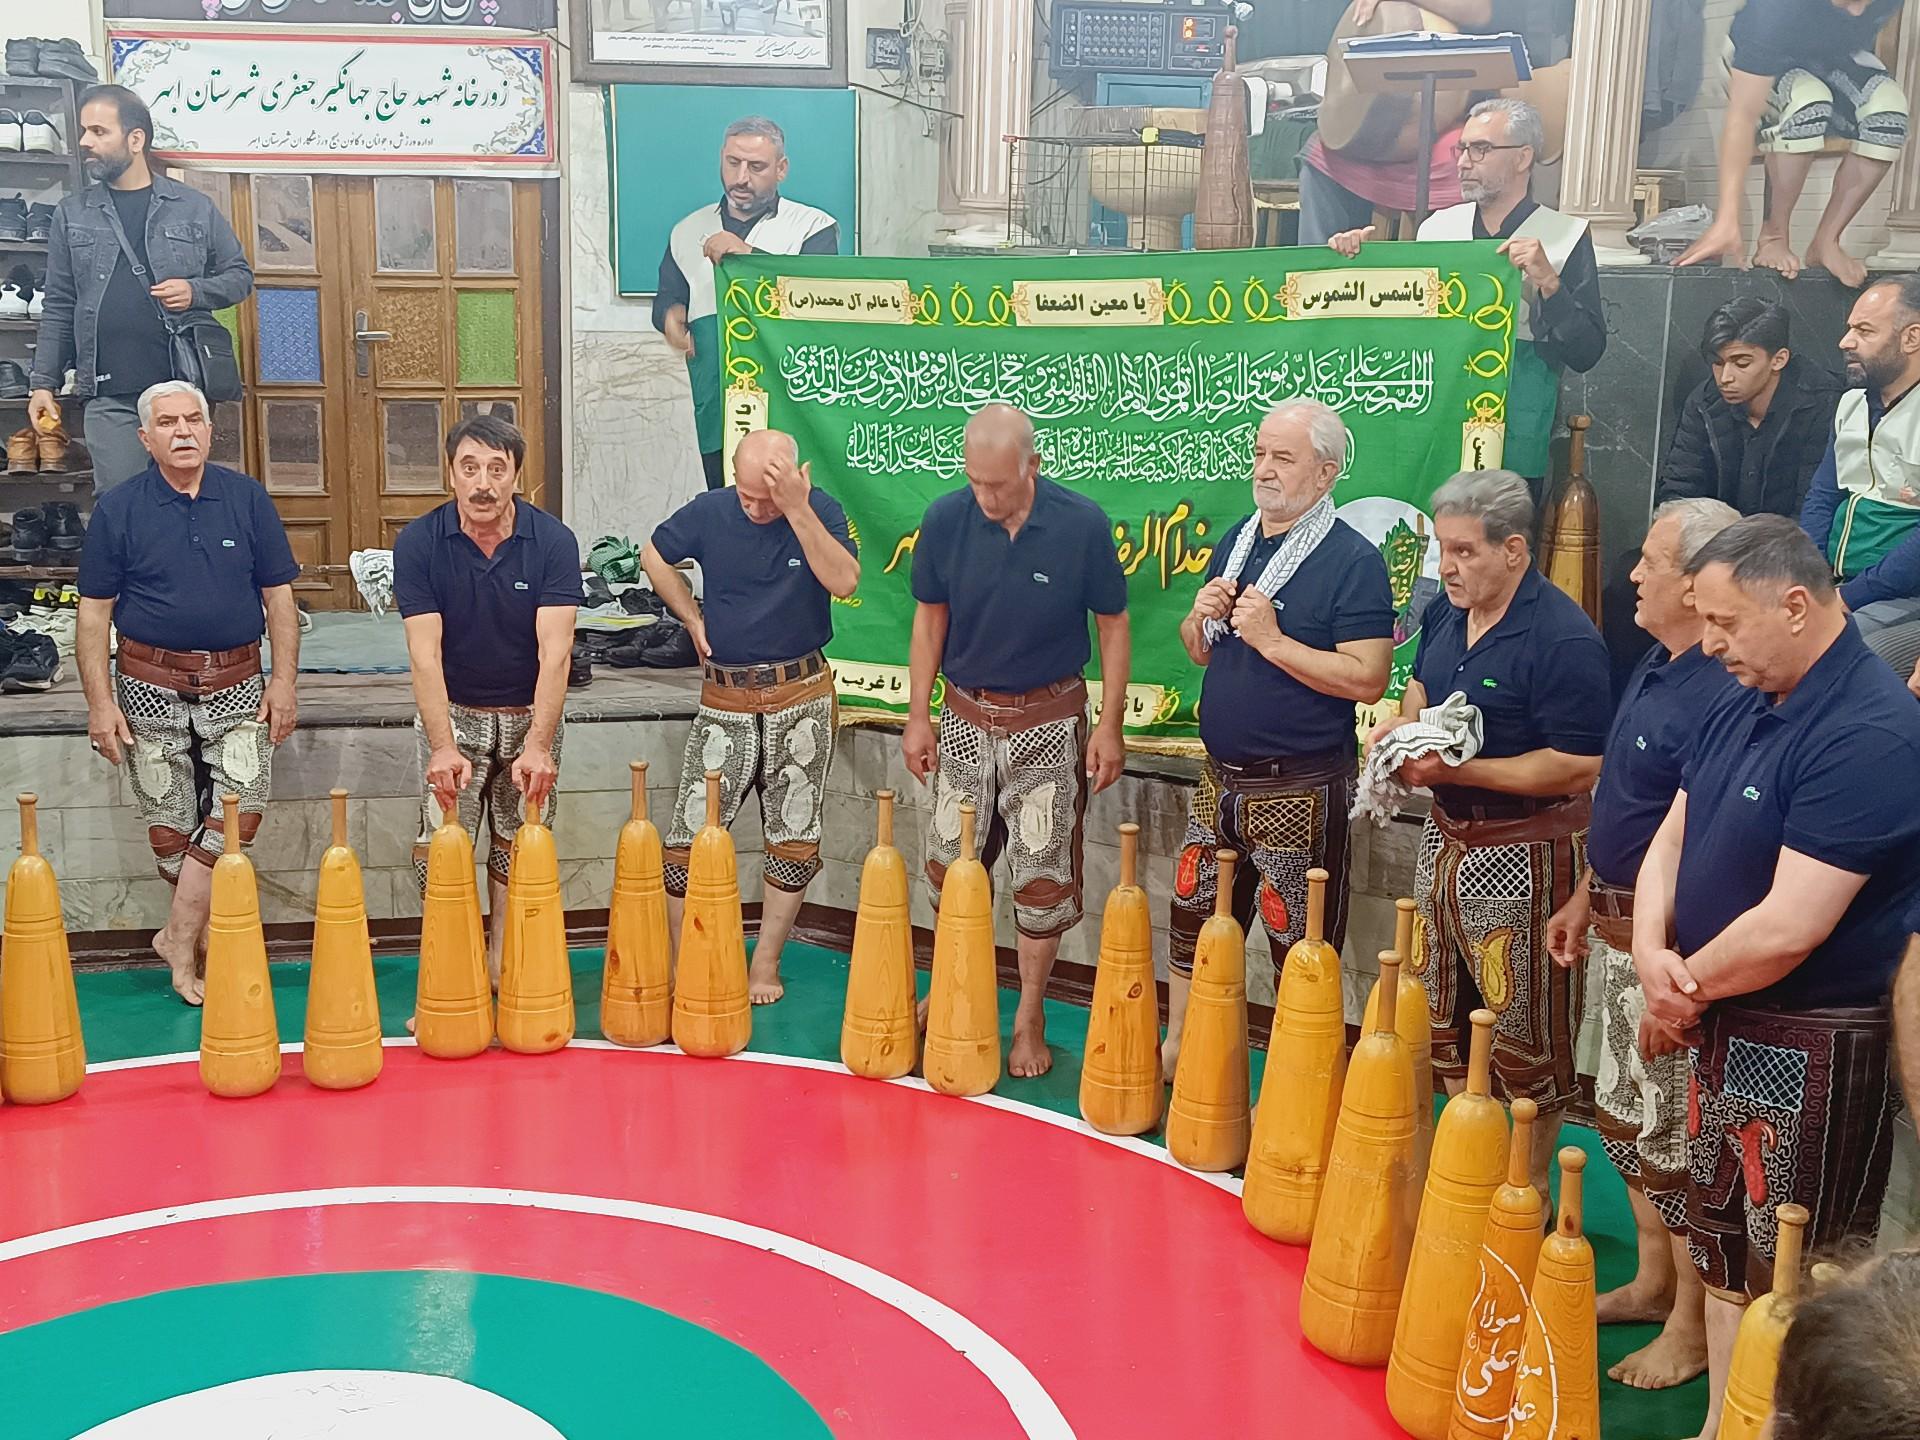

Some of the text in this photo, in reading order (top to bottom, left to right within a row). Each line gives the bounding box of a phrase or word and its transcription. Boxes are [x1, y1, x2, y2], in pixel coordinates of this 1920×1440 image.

[150, 48, 508, 124] زورخانه شهید حاج جهانگیر جعفری شهرستان ابهر
[847, 292, 862, 311] آل
[866, 294, 889, 311] عالم
[891, 295, 902, 312] یا
[1035, 291, 1147, 317] یا معین الضعفا
[1302, 280, 1365, 310] الشموس
[1160, 503, 1213, 590] خدام
[841, 674, 886, 692] غریب
[889, 676, 902, 694] یا
[1480, 1299, 1521, 1333] مولا
[1462, 1337, 1519, 1397] علی
